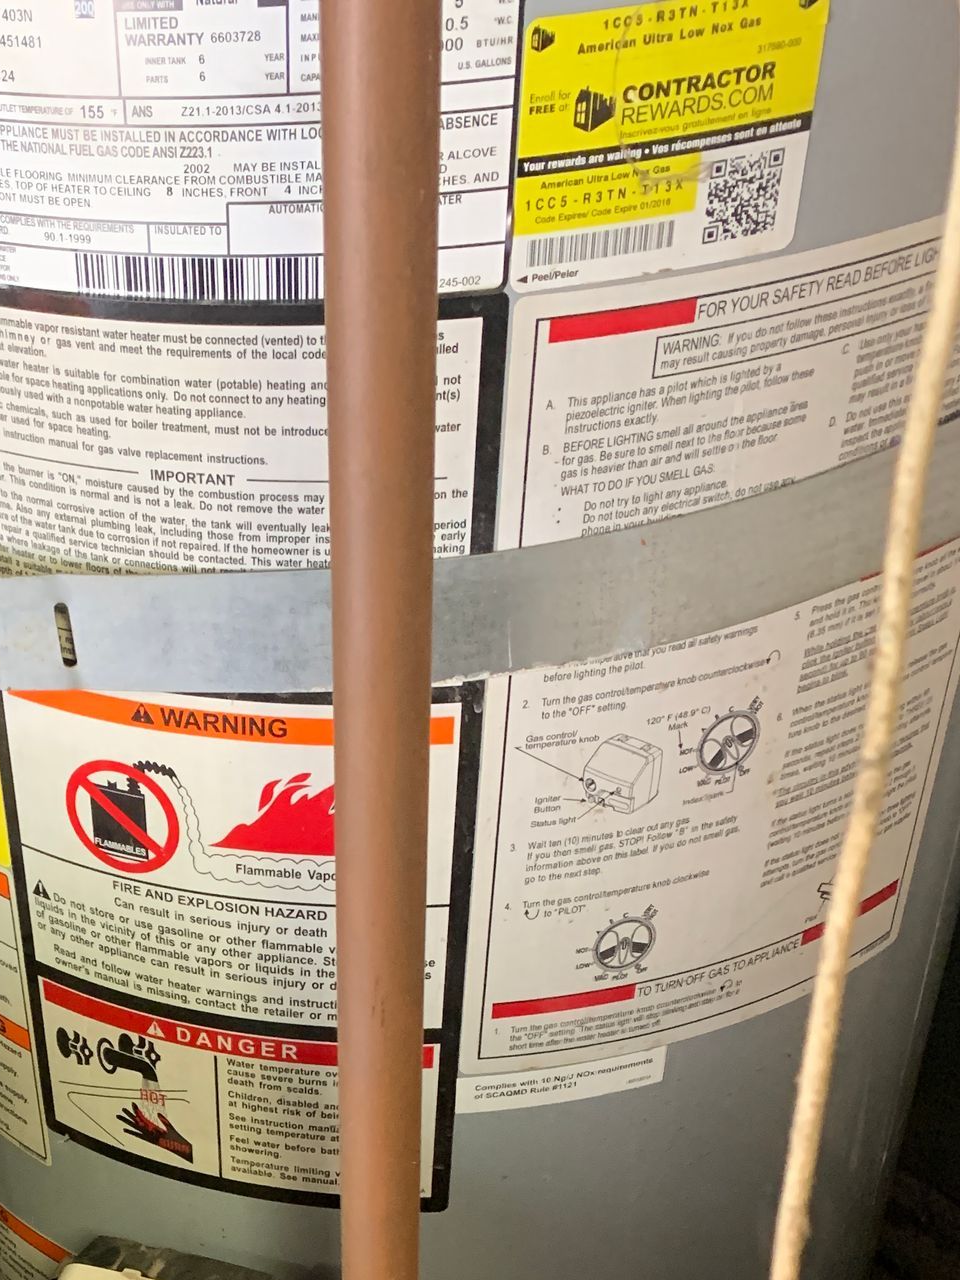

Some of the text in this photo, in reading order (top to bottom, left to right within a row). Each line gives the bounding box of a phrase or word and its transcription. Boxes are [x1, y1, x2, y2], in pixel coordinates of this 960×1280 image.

[125, 16, 179, 30] LIMITED
[125, 30, 261, 47] WARRANTY 6603728
[476, 36, 514, 48] BTU/HR
[578, 17, 761, 55] American Ultra Low Nox Gas
[145, 53, 285, 65] INNER TANK 6 YEAR
[457, 56, 512, 71] U.S. GALLONS
[623, 61, 776, 103] CONTRACTOR
[530, 90, 571, 103] Enroll for
[620, 83, 775, 125] REWARDS.COM
[80, 105, 105, 119] 155
[132, 104, 271, 119] ANS Z21.1-2013/CSA
[529, 104, 555, 115] FREE
[51, 128, 79, 141] MUST
[83, 129, 97, 142] BE
[101, 129, 161, 143] INSTALLED
[165, 130, 176, 143] IN
[179, 129, 262, 143] ACCORDANCE
[266, 128, 297, 141] WITH
[447, 147, 497, 160] ALCOVE
[524, 161, 545, 172] Your
[547, 155, 586, 169] rewards
[589, 153, 604, 163] are
[652, 144, 669, 155] Vos
[671, 133, 732, 153] récompenses
[734, 130, 755, 140] sont
[756, 126, 767, 136] en
[770, 119, 802, 134] attente
[183, 164, 210, 174] 2002
[474, 171, 500, 184] AND
[44, 232, 91, 244] 90.1-1999
[154, 225, 222, 235] INSULATED TO
[531, 268, 579, 282] Peel/Peler
[697, 256, 913, 321] FOR YOUR SAFETY READ BEFORE
[34, 322, 58, 333] vapor
[61, 326, 100, 338] resistant
[102, 329, 127, 340] water
[130, 332, 160, 343] heater
[162, 334, 188, 344] must
[190, 334, 202, 344] be
[205, 334, 258, 345] connected
[261, 335, 304, 348] (vented)
[662, 334, 722, 355] WARNING:
[150, 469, 235, 486] IMPORTANT
[560, 464, 715, 496] WHAT TO DO IF YOU SMELL GAS:
[160, 707, 288, 738] WARNING
[530, 816, 577, 829] Status light
[236, 864, 302, 880] Flammable
[112, 881, 328, 921] FIRE AND EXPLOSION HAZARD
[114, 897, 328, 938] Can result in serious injury or death
[638, 939, 801, 998] TO TURN OFF GAS TO APPLIANCE
[176, 1027, 299, 1060] DANGER
[474, 1081, 517, 1092] Complies
[576, 1068, 595, 1078] NOx
[596, 1057, 654, 1076] requirements
[140, 1088, 167, 1106] HOT
[485, 1087, 528, 1099] SCAQMD
[529, 1085, 550, 1094] Rule
